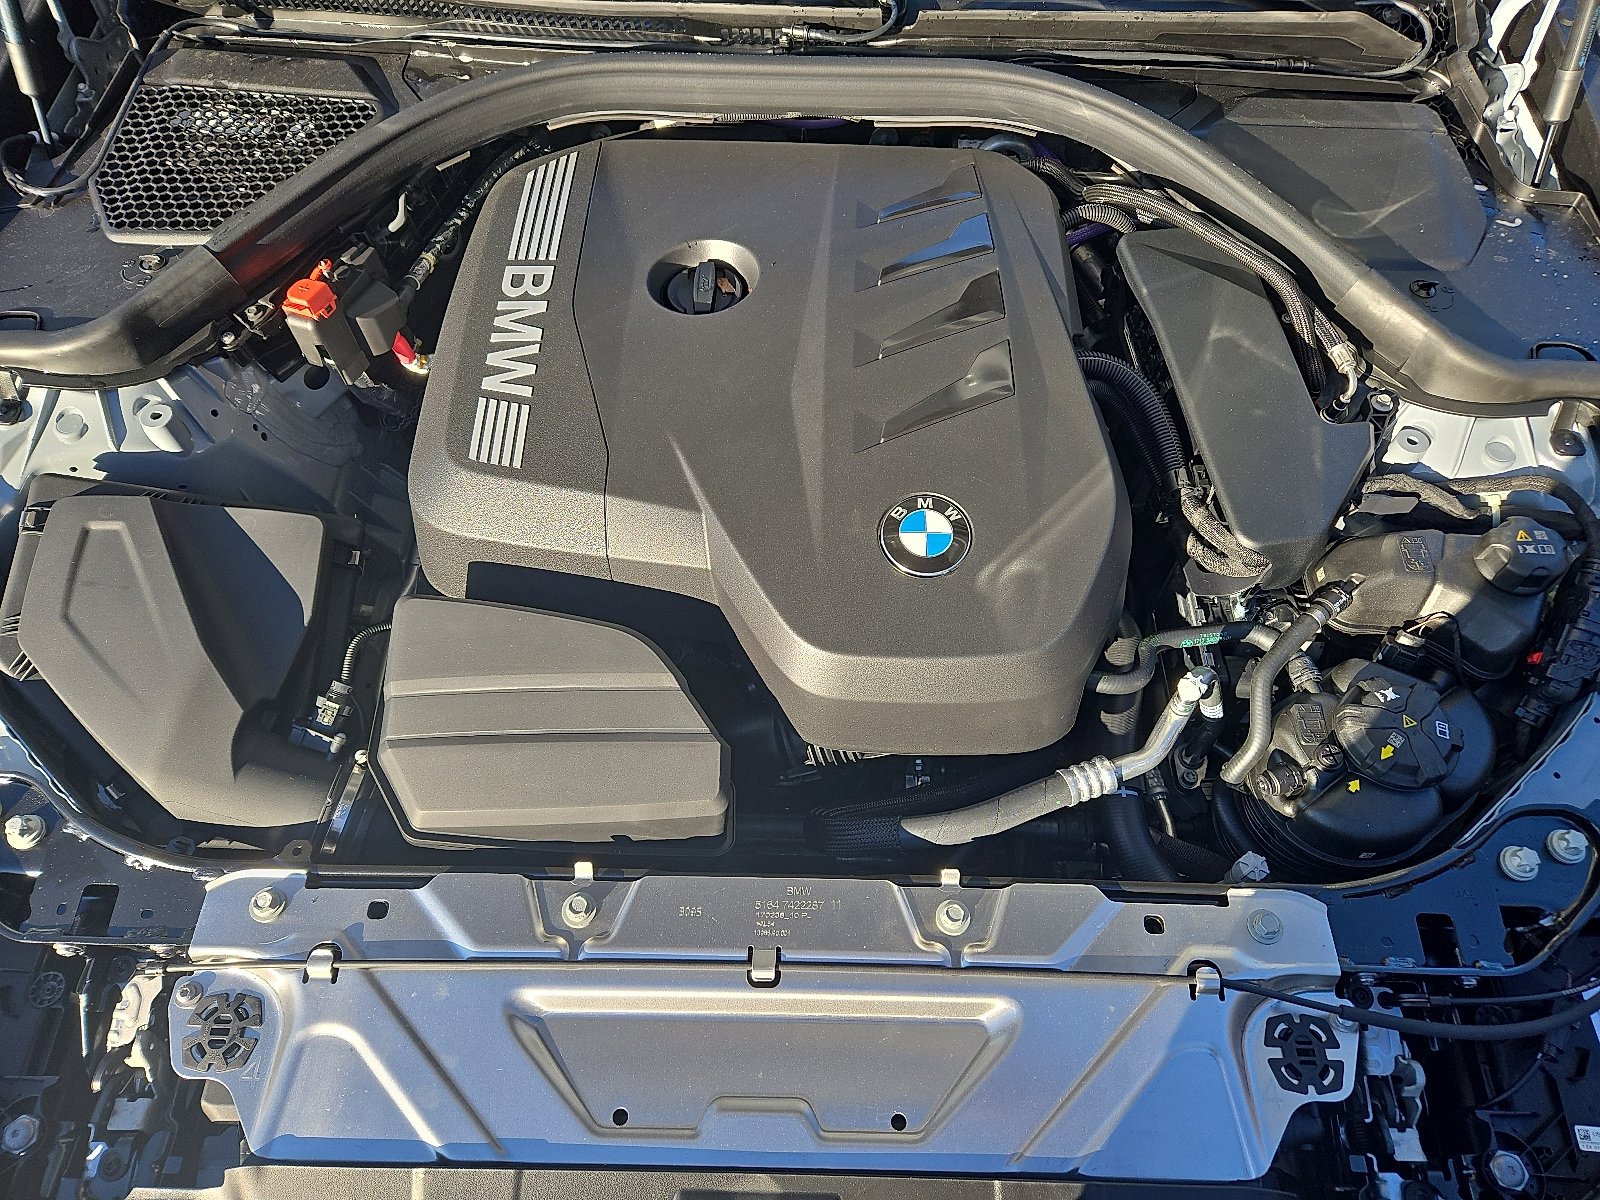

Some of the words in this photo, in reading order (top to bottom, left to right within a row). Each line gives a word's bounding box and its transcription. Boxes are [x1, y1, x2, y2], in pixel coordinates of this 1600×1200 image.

[480, 265, 555, 398] BMW
[889, 497, 961, 522] BMW
[786, 886, 812, 896] BMW
